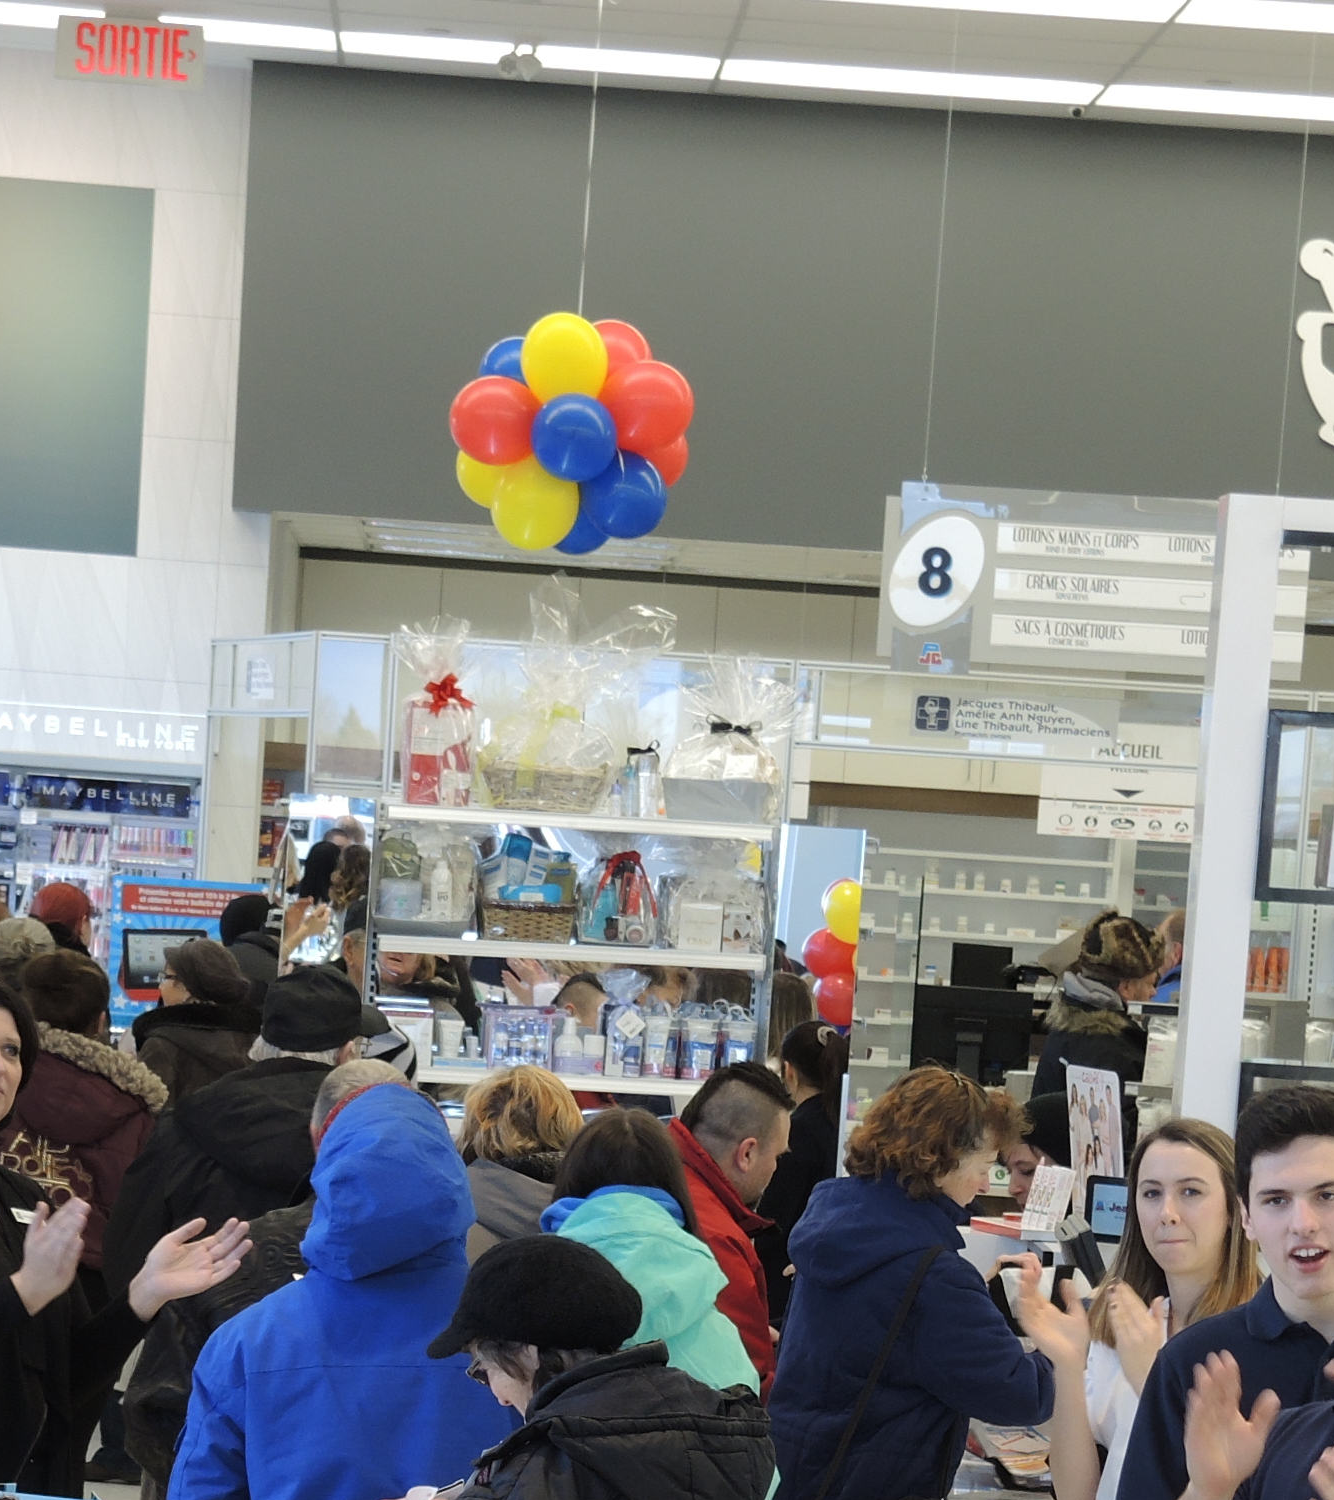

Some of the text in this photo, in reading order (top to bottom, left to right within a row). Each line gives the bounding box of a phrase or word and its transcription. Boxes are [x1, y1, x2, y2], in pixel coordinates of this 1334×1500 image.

[75, 22, 190, 81] SORTIE
[1013, 527, 1055, 545] LOTIONS
[1058, 530, 1091, 546] MAINS
[1105, 533, 1139, 549] CORPS
[1168, 537, 1211, 554] LOTIONS
[918, 547, 953, 599] 8
[1026, 573, 1119, 594] CRÈMES SOLAIRES
[1014, 619, 1041, 636] SACS
[1054, 621, 1125, 641] COSMÉTIQUES
[957, 698, 1058, 713] Jacques Thibault,
[956, 709, 1075, 726] Amélie Anh Nguyen,
[955, 719, 1110, 738] Line Thibault, Pharmaciens
[116, 737, 196, 751] NEW YORK
[43, 785, 176, 804] MAYBELLINE
